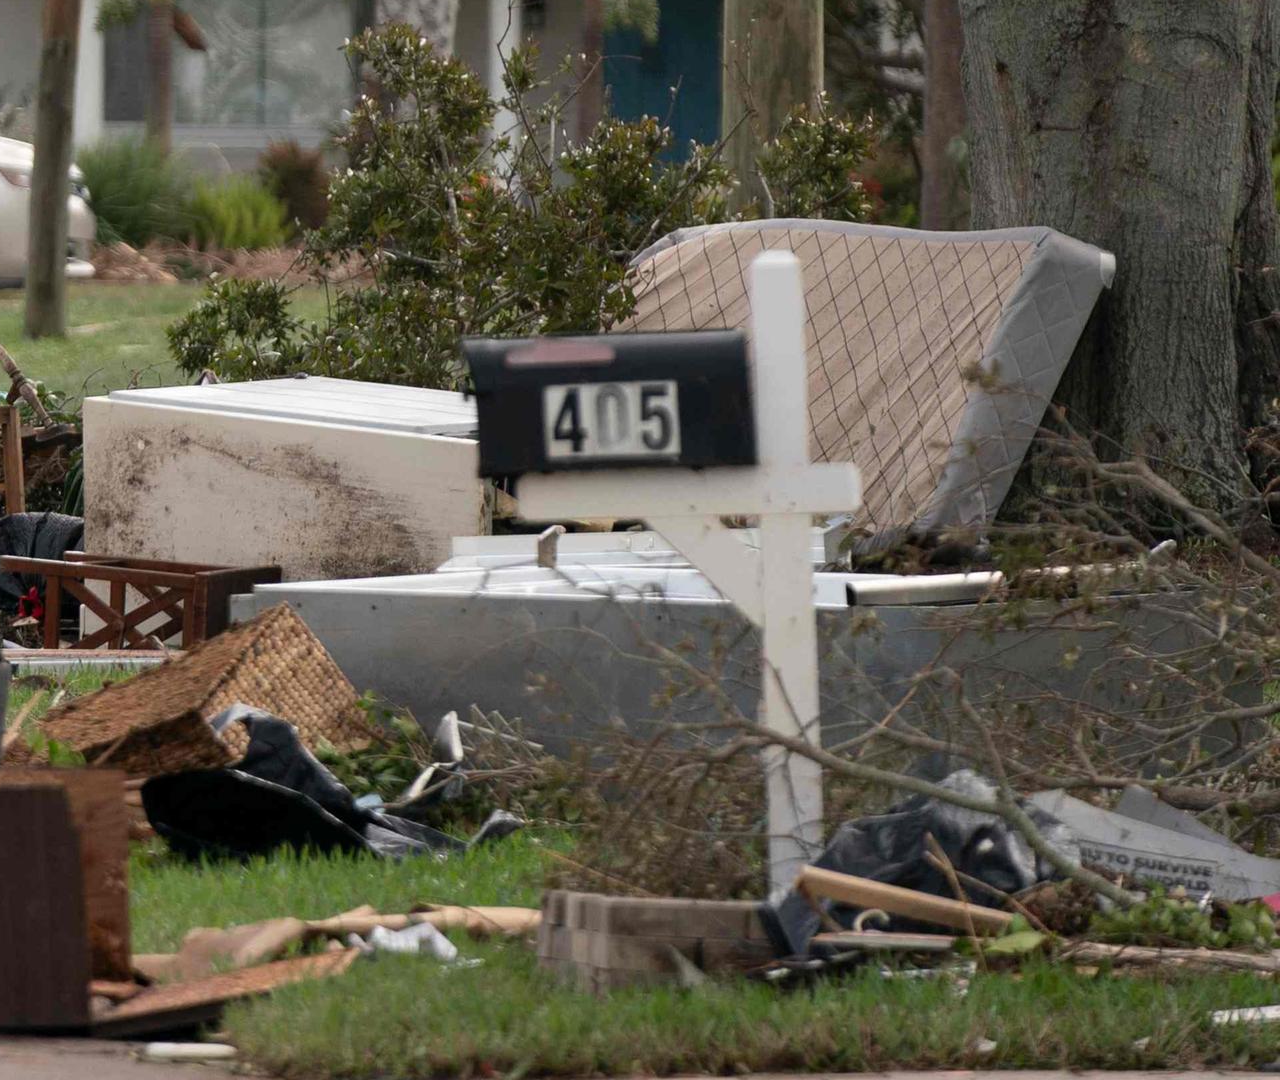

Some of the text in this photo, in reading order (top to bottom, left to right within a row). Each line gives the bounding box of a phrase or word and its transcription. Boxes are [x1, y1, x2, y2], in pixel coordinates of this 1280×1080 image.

[553, 382, 673, 453] 405
[1104, 851, 1130, 866] TO
[1134, 857, 1213, 876] SURVIVE
